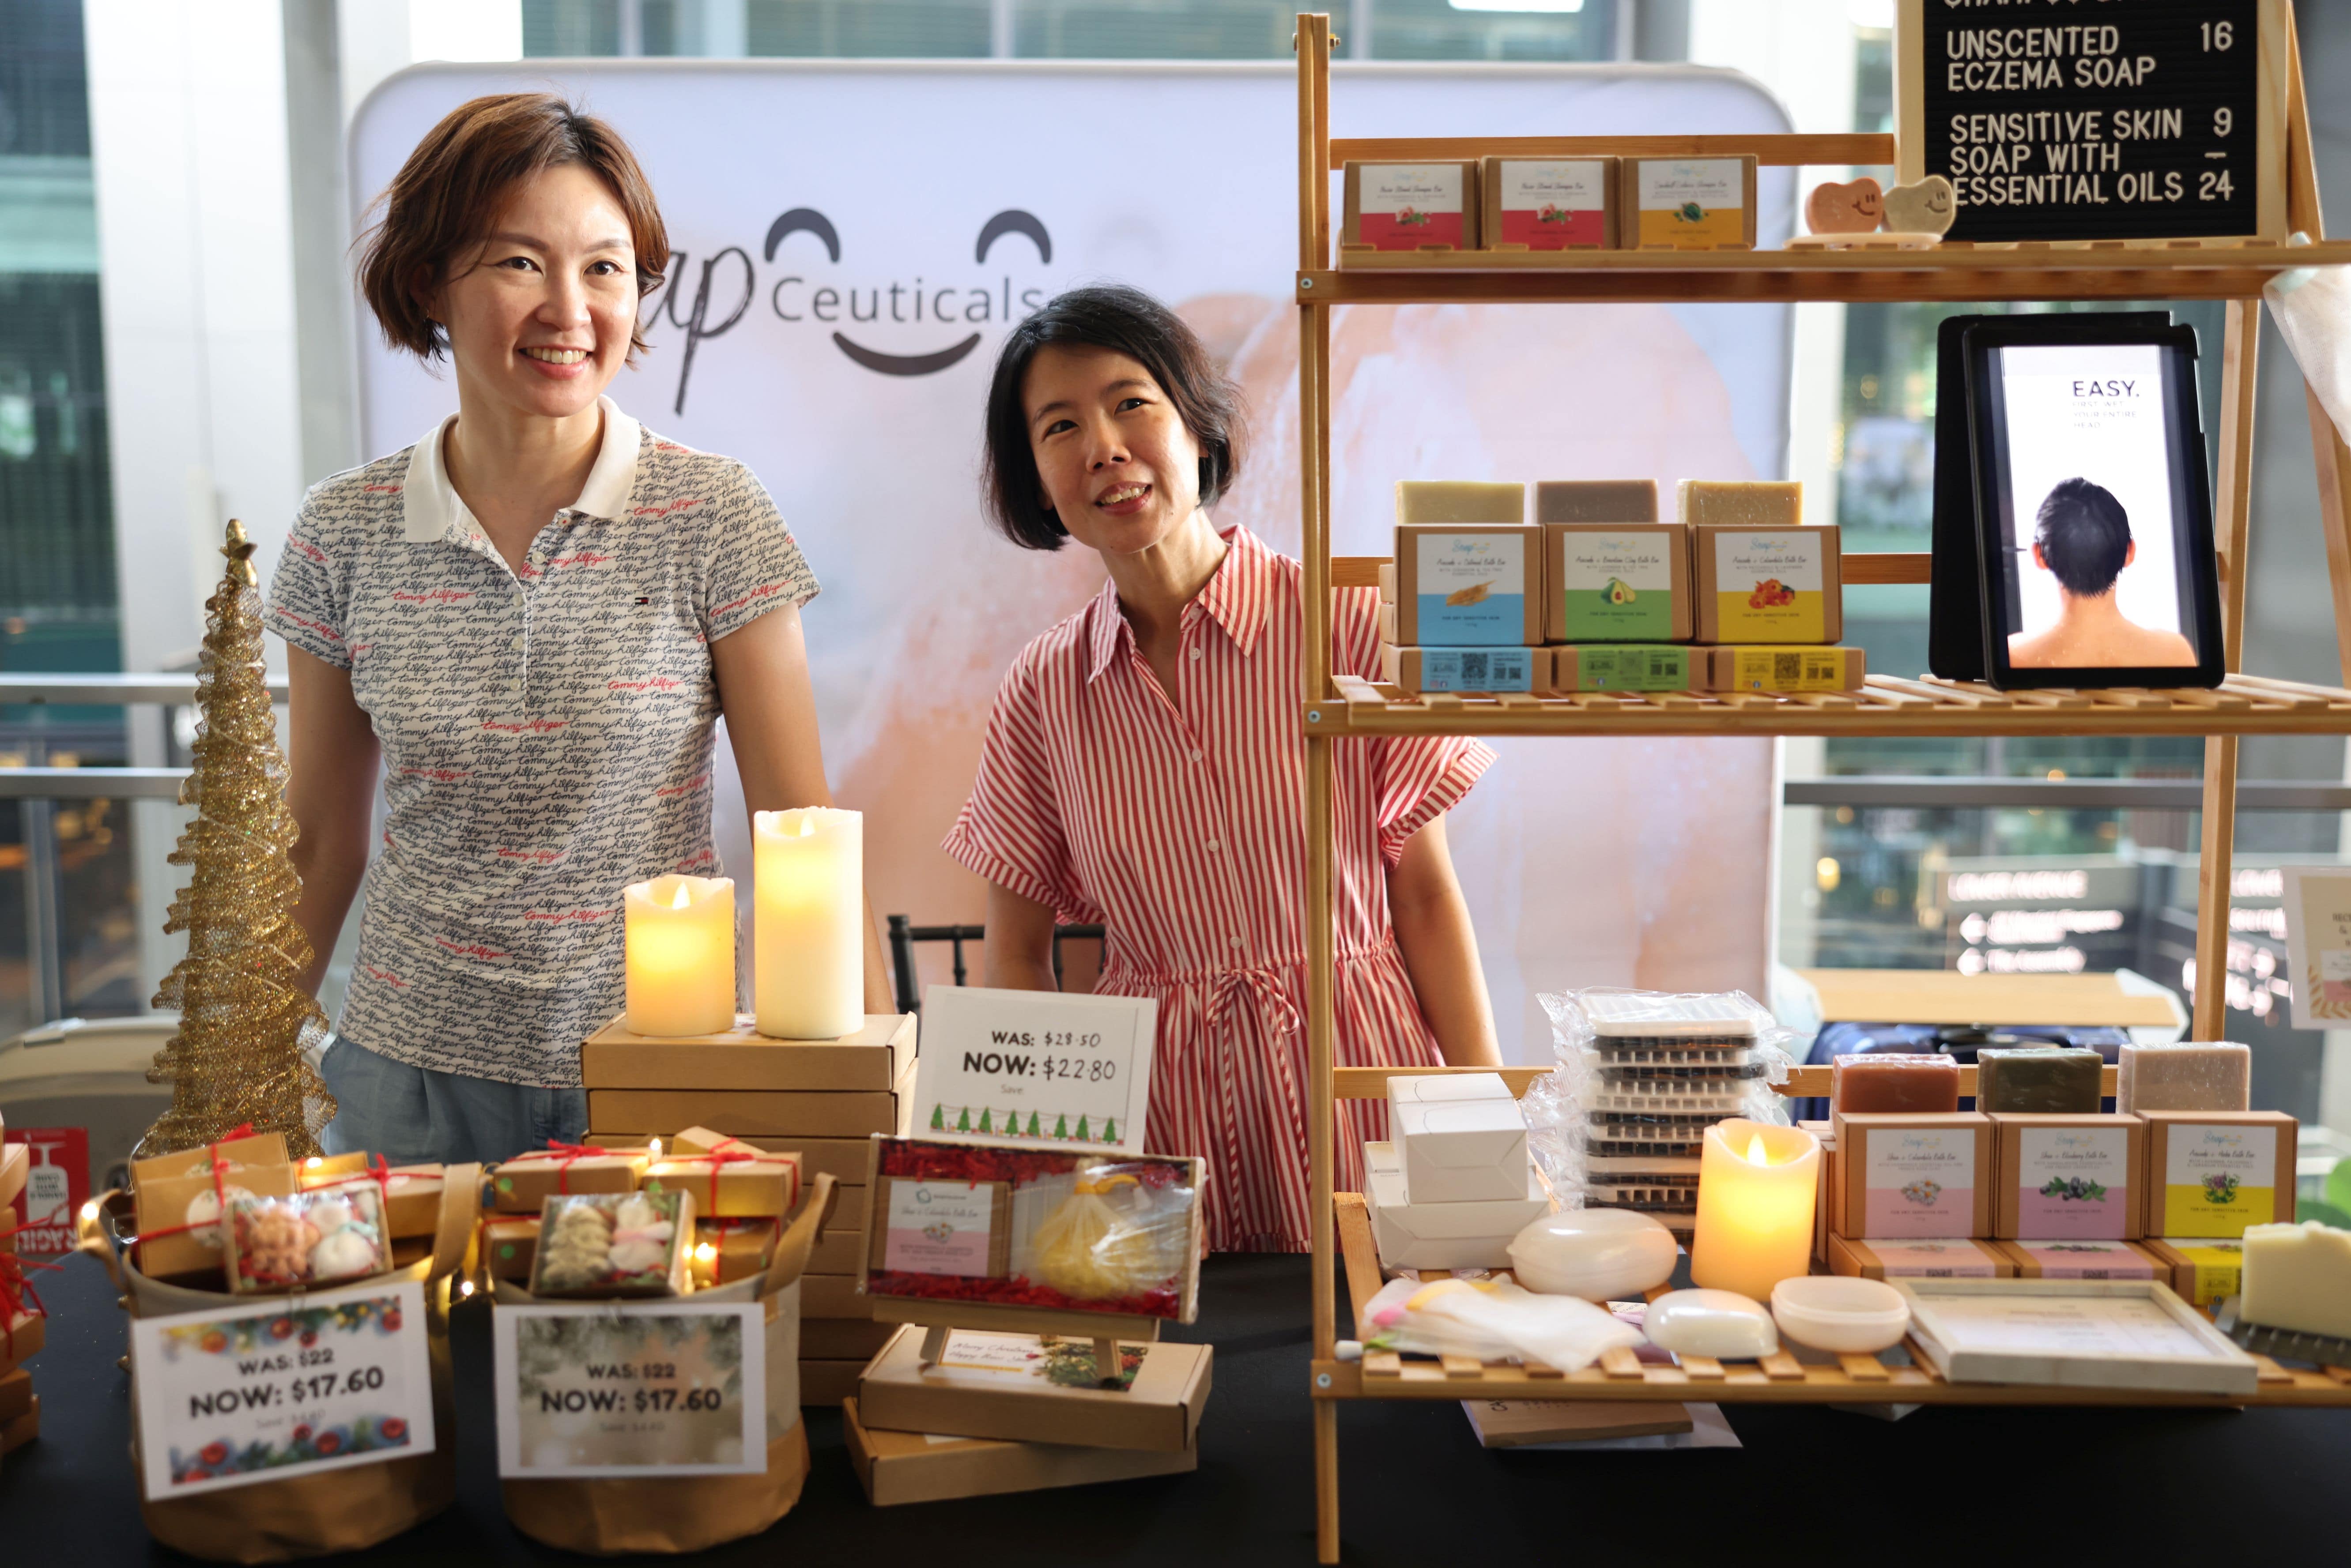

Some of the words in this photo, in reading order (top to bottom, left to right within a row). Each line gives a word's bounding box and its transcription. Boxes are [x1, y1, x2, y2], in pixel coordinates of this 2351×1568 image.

[1947, 25, 2119, 59] UNSCENTED
[2201, 22, 2234, 52] 16
[1947, 59, 2062, 91] ECZEMA
[2074, 56, 2156, 88] SOAP
[1949, 111, 2102, 144] SENSITIVE
[2113, 108, 2182, 140] SKIN
[2213, 107, 2233, 137] 9
[1949, 144, 2031, 175] SOAP
[2046, 143, 2119, 172] WITH
[1951, 174, 2109, 206] ESSENTIAL
[2118, 172, 2183, 202] OILS
[2198, 170, 2234, 201] 24
[772, 277, 1044, 323] Ceuticals
[2072, 381, 2140, 397] EASY.
[630, 493, 667, 506] hilfiger
[672, 490, 704, 499] tommy
[349, 504, 385, 515] tommy
[634, 505, 668, 517] tommy
[668, 498, 698, 512] hilfiger
[341, 525, 376, 538] tommy
[576, 543, 610, 555] tommy
[613, 541, 653, 554] hilfiger
[408, 557, 438, 572] hilfiger
[444, 556, 477, 569] tommy
[574, 551, 608, 566] hilfiger
[615, 555, 648, 565] tommy
[367, 571, 404, 584] hilfiger
[411, 570, 442, 581] tommy
[446, 566, 477, 580] hilfiger
[576, 566, 610, 577] tommy
[614, 563, 648, 577] hilfiger
[566, 575, 605, 589] hilfiger
[611, 577, 648, 588] tommy
[393, 591, 426, 605] tommy
[430, 589, 468, 603] hilfiger
[562, 590, 600, 603] tommy
[600, 586, 636, 600] hilfiger
[711, 598, 748, 617] tommy
[750, 584, 786, 598] hilfiger
[389, 603, 428, 618] hilfiger
[434, 603, 470, 615] tommy
[552, 599, 593, 613] hilfiger
[600, 600, 635, 612] tommy
[550, 614, 589, 626] tommy
[592, 611, 626, 625] hilfiger
[374, 629, 410, 642] hilfiger
[417, 628, 453, 642] tommy
[371, 641, 404, 653] tommy
[406, 639, 440, 653] hilfiger
[446, 639, 484, 653] tommy
[574, 647, 611, 659] tommy
[618, 644, 658, 658] hilfiger
[530, 660, 565, 671] tommy
[570, 657, 612, 671] hilfiger
[618, 656, 656, 669] tommy
[398, 674, 432, 686] tommy
[437, 672, 481, 686] hilfiger
[557, 682, 602, 695] hilfiger
[608, 680, 646, 691] tommy
[389, 699, 420, 712] tommy
[423, 697, 470, 712] hilfiger
[563, 694, 603, 706] tommy
[607, 691, 644, 705] hilfiger
[549, 705, 594, 719] hilfiger
[600, 705, 638, 719] tommy
[396, 727, 428, 739] tommy
[431, 723, 473, 737] hilfiger
[400, 767, 426, 777] tommy
[427, 769, 468, 781] hilfiger
[473, 769, 509, 781] tommy
[513, 766, 548, 781] hilfiger
[508, 780, 547, 794] tommy
[550, 779, 592, 792] hilfiger
[498, 847, 530, 862] tommy
[532, 849, 565, 863] hilfiger
[435, 936, 465, 953] tommy
[468, 945, 503, 960] hilfiger
[992, 1031, 1035, 1046] WAS:
[963, 1052, 1036, 1077] NOW:
[238, 1357, 294, 1376] WAS:
[299, 1348, 334, 1366] $22
[587, 1364, 638, 1380] WAS:
[643, 1363, 676, 1380] $22
[189, 1384, 283, 1419] NOW:
[292, 1366, 384, 1403] $17.60
[540, 1389, 626, 1412] NOW:
[634, 1387, 722, 1413] $17.60
